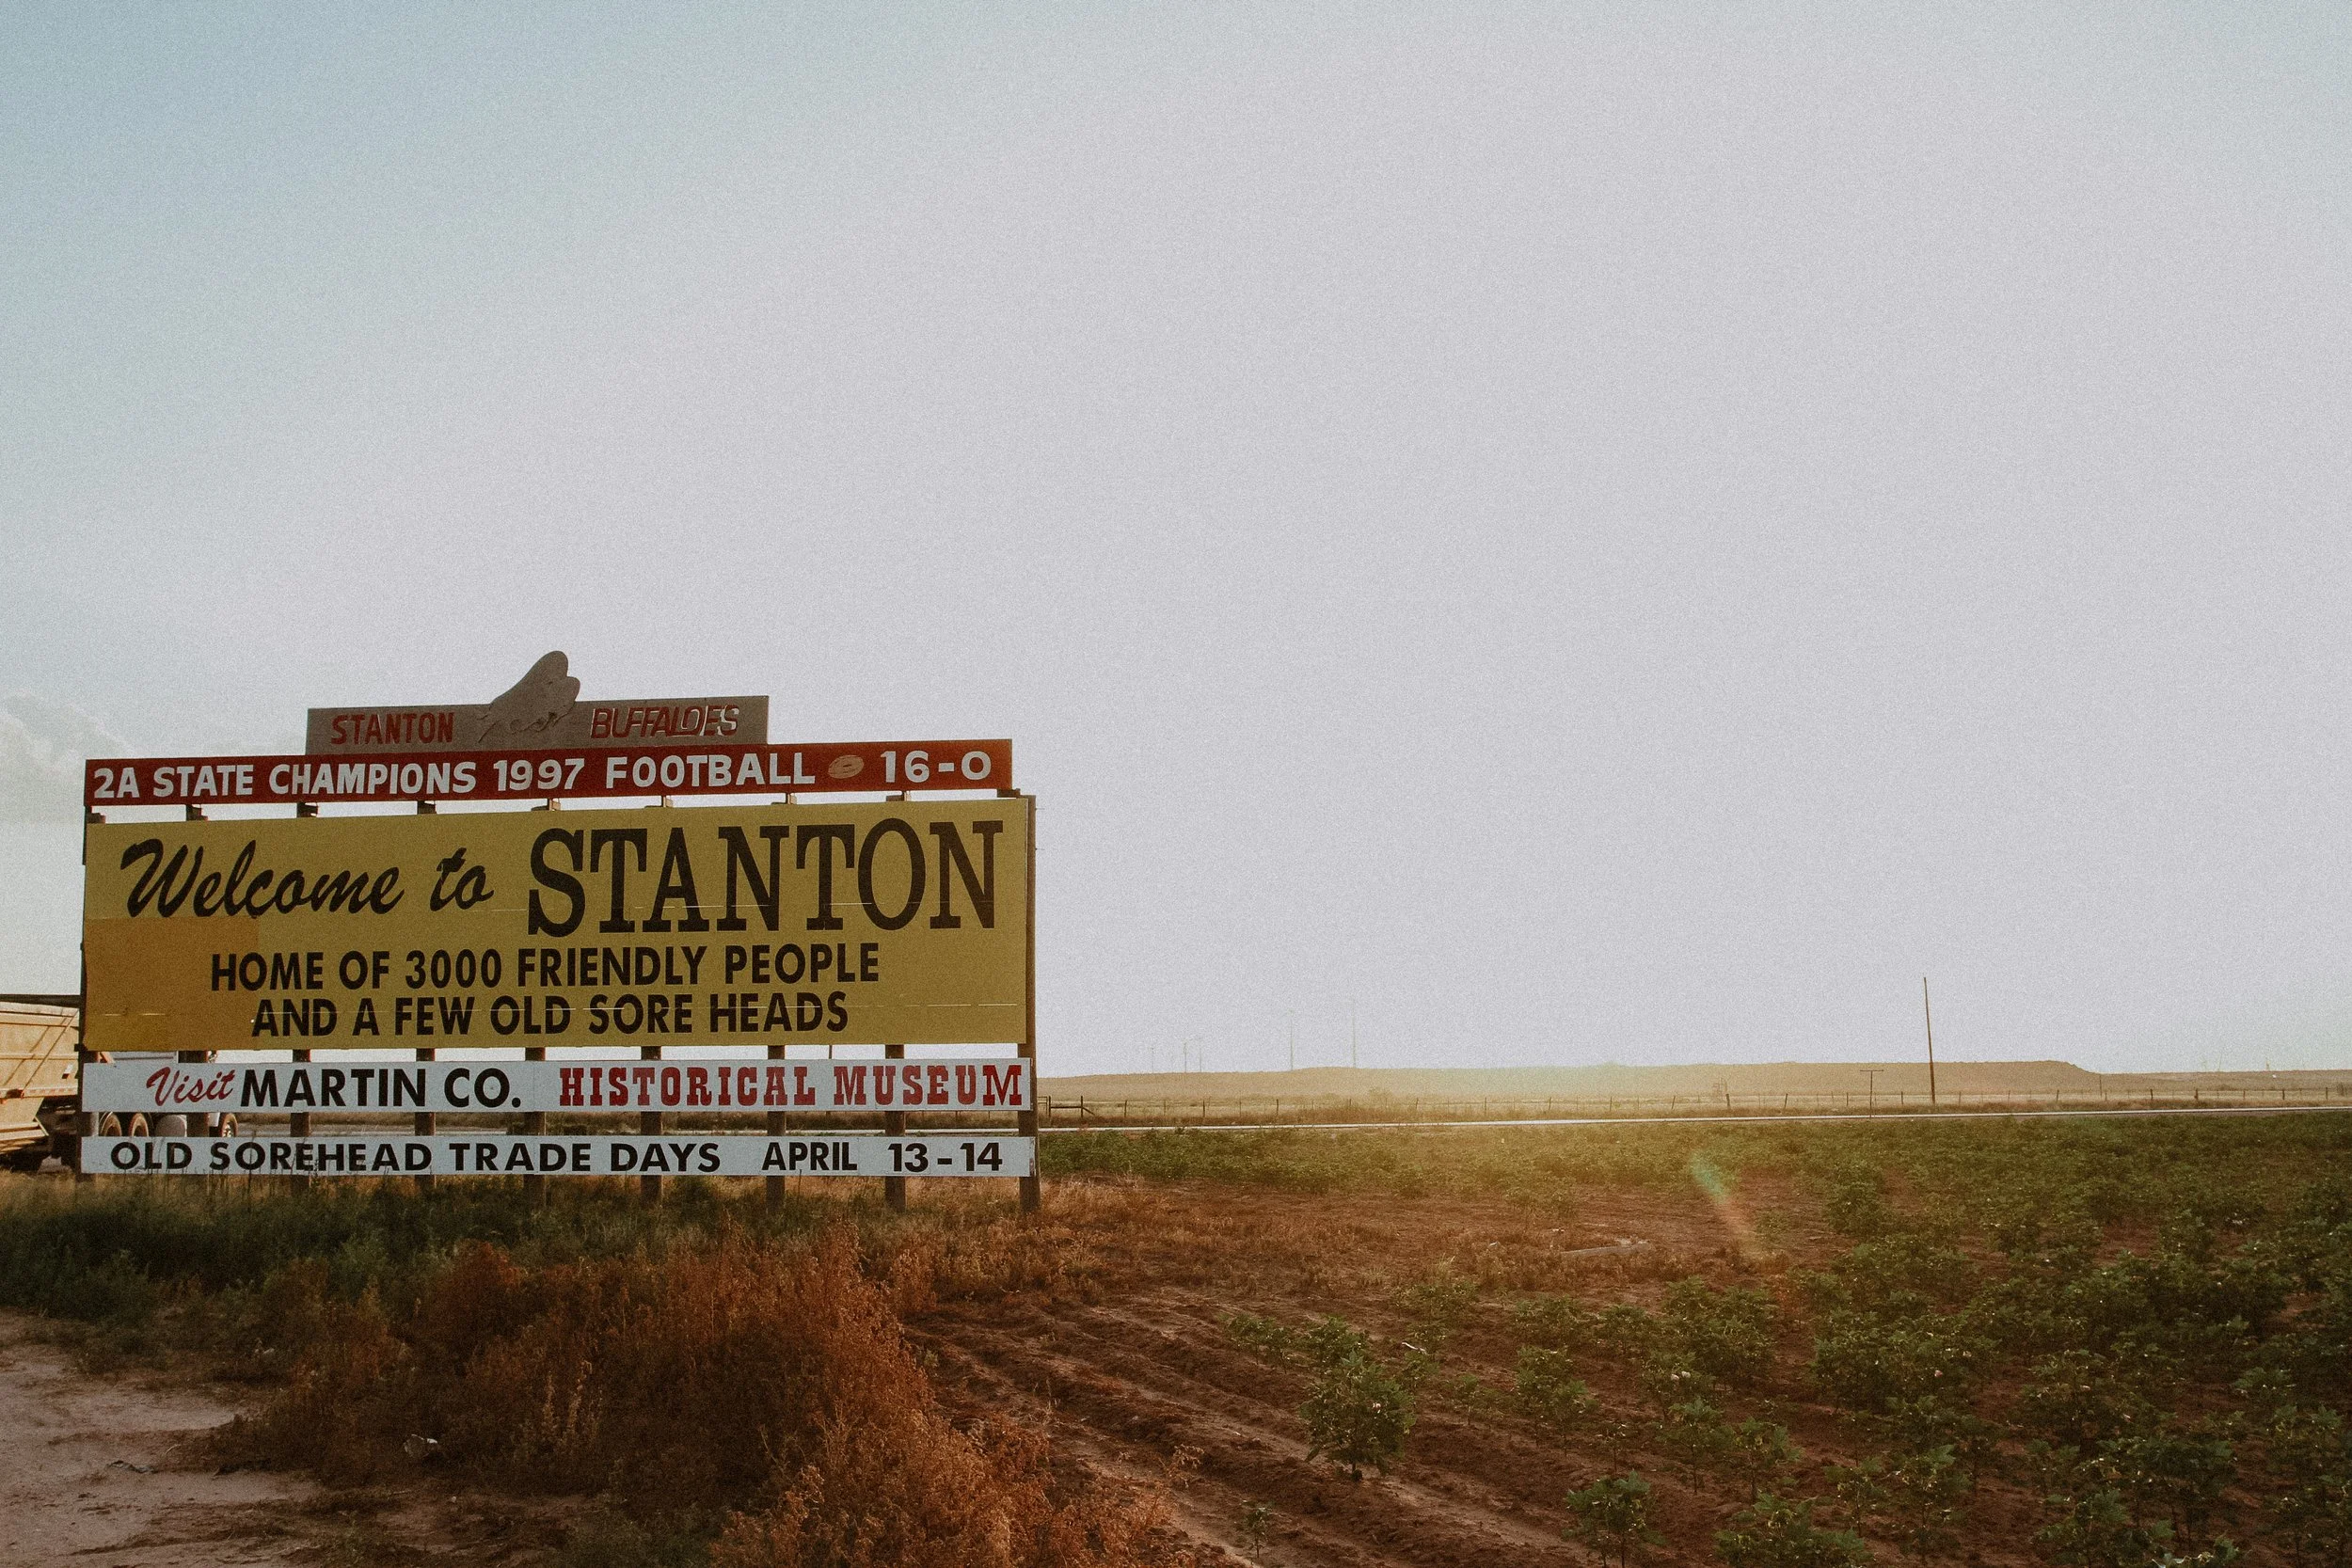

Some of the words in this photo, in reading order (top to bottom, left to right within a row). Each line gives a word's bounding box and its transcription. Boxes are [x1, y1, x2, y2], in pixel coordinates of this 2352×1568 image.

[331, 711, 455, 745] STANTON
[591, 705, 740, 739] BUFFALOES
[94, 767, 140, 799] 2A
[152, 764, 254, 798] STATE
[269, 761, 477, 796] CHAMPIONS
[492, 758, 586, 792] 1997
[605, 752, 816, 789] FOOTBALL
[119, 838, 405, 919] Welcome
[429, 847, 495, 912] to
[527, 816, 1004, 939] STANTON
[211, 951, 324, 991] HOME
[339, 949, 390, 990] OF
[405, 948, 502, 989] 3000
[516, 944, 707, 988] FRIENDLY
[724, 942, 880, 986] PEOPLE
[250, 997, 338, 1037] AND
[352, 996, 380, 1036] A
[394, 995, 475, 1036] FEW
[489, 993, 571, 1035] OLD
[588, 992, 693, 1035] SORE
[709, 990, 849, 1034] HEADS
[146, 1066, 236, 1106] Visit
[240, 1067, 426, 1108] MARTIN
[443, 1067, 523, 1109] CO.
[559, 1065, 816, 1107] HISTORICAL
[833, 1063, 1023, 1106] MUSEUM
[109, 1141, 193, 1171] OLD
[209, 1141, 433, 1172] SOREHEAD
[449, 1141, 591, 1173] TRADE
[610, 1142, 722, 1173] DAYS
[761, 1141, 858, 1172] APRIL
